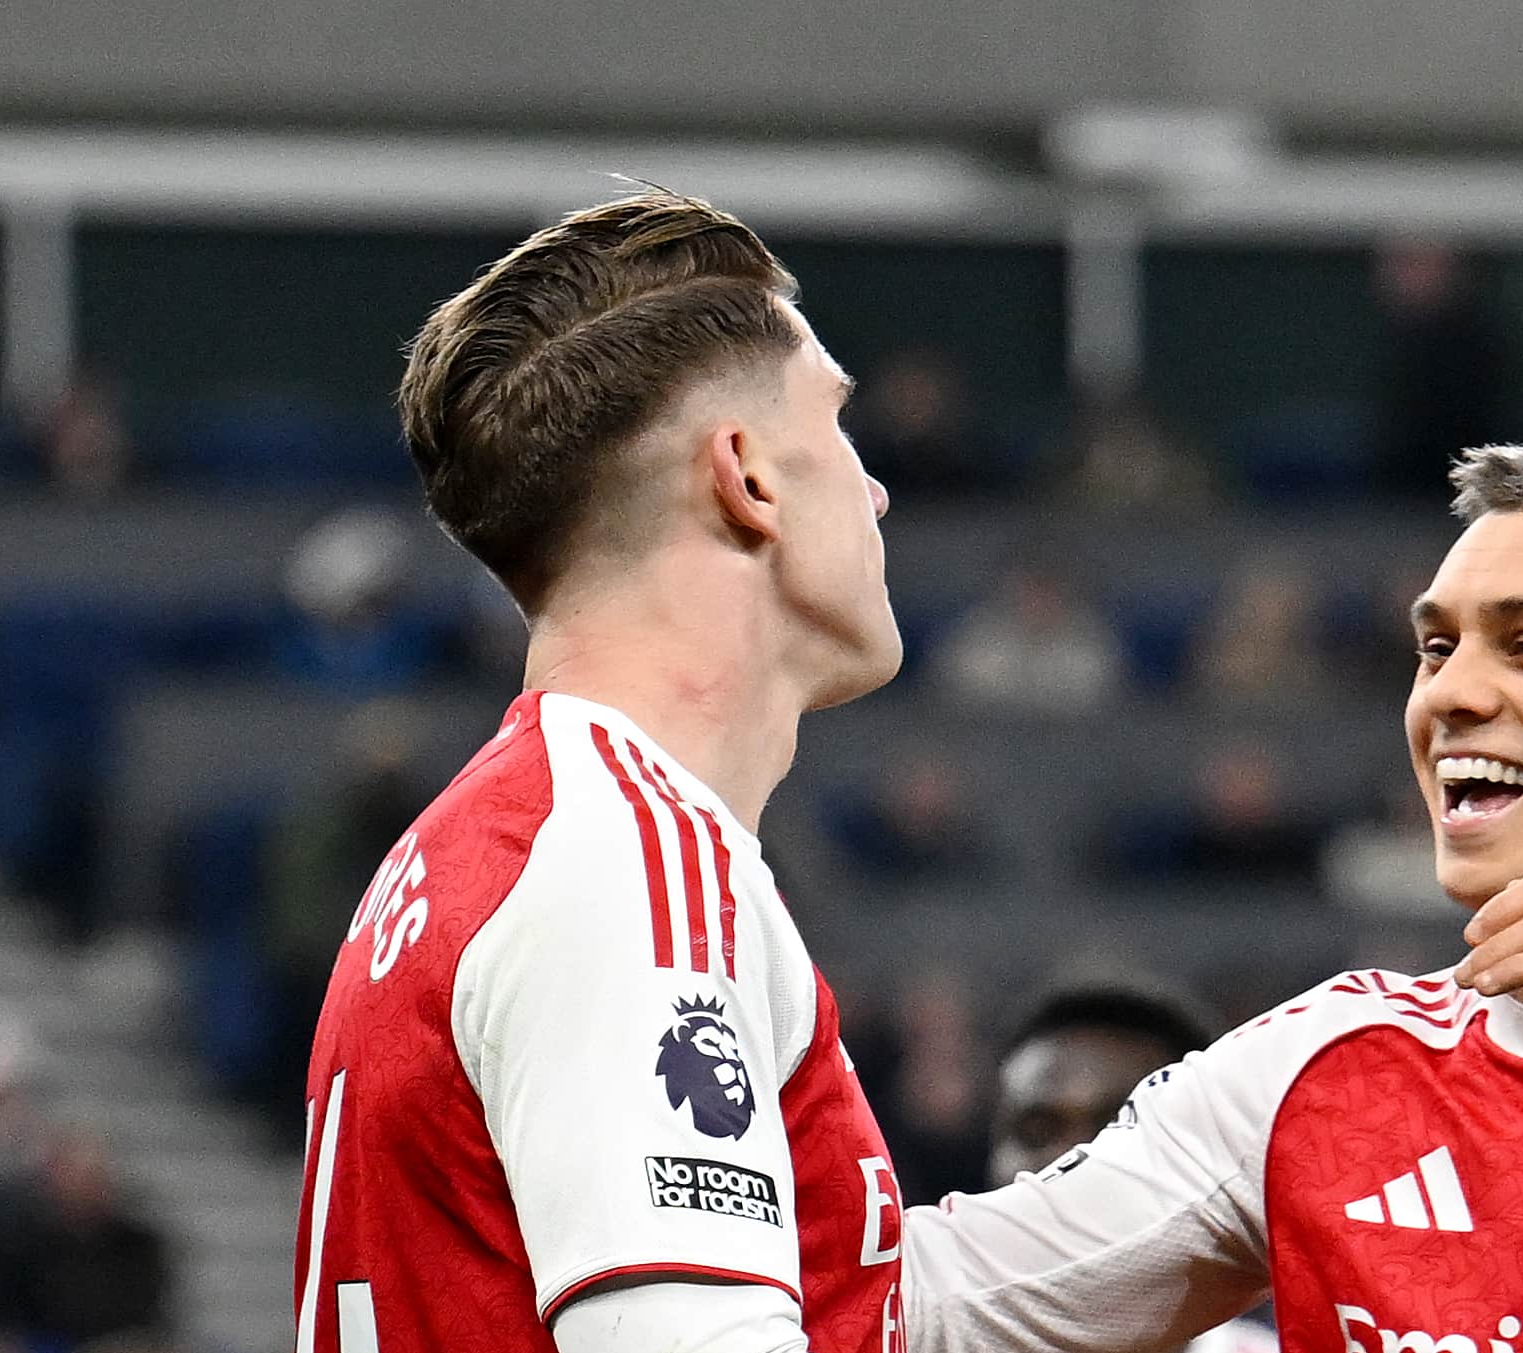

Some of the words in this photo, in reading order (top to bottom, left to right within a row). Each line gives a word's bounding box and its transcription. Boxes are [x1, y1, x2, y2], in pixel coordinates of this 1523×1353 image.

[646, 1158, 693, 1184] No
[697, 1166, 769, 1200] room
[651, 1181, 694, 1207] for
[698, 1189, 783, 1227] racism
